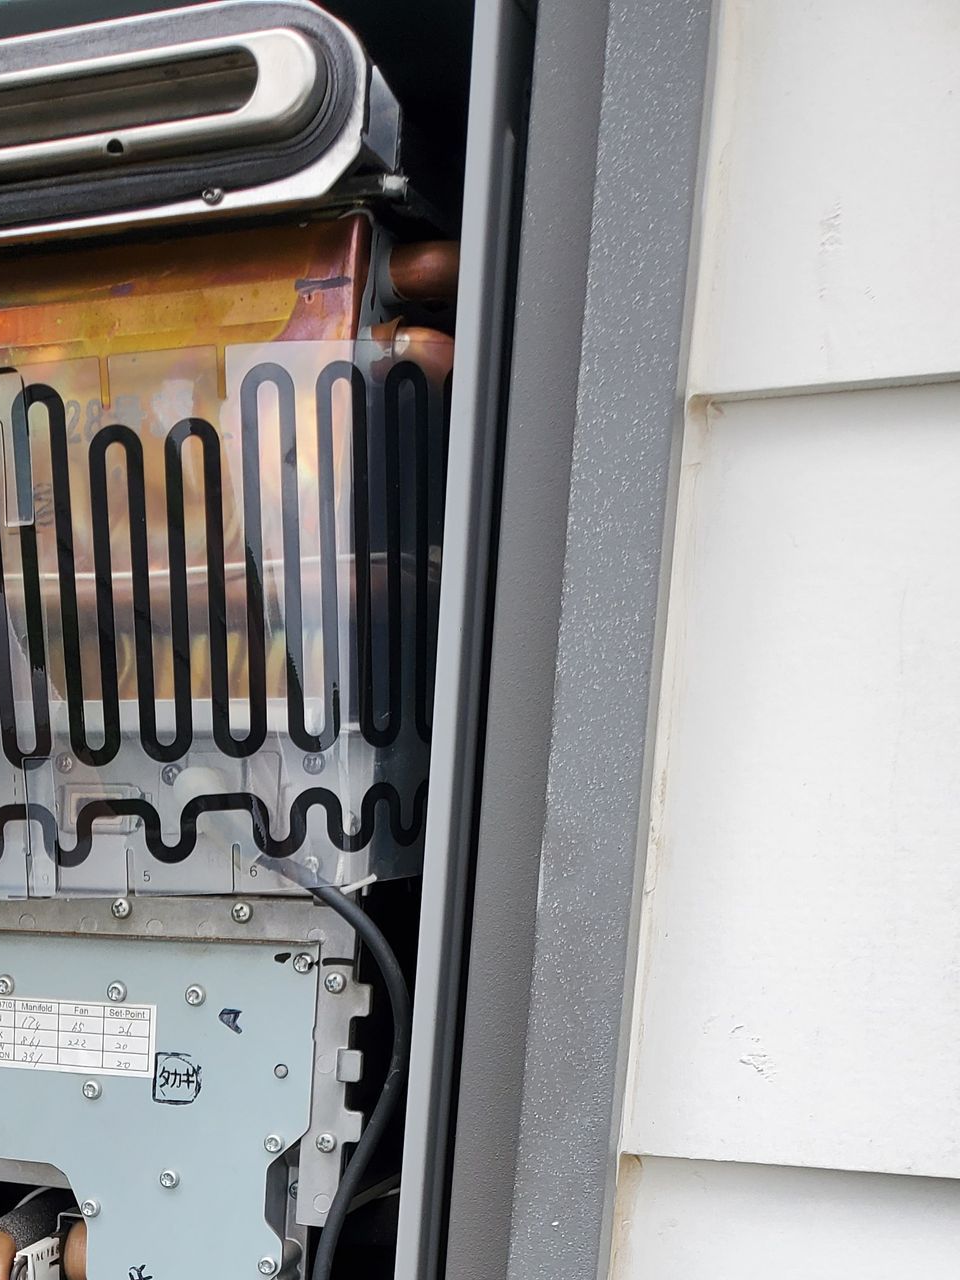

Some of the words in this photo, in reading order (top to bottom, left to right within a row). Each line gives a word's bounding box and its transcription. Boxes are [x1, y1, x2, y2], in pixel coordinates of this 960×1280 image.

[21, 1003, 53, 1012] Manifold
[74, 1007, 89, 1015] Fan
[109, 1009, 146, 1018] Set-Point
